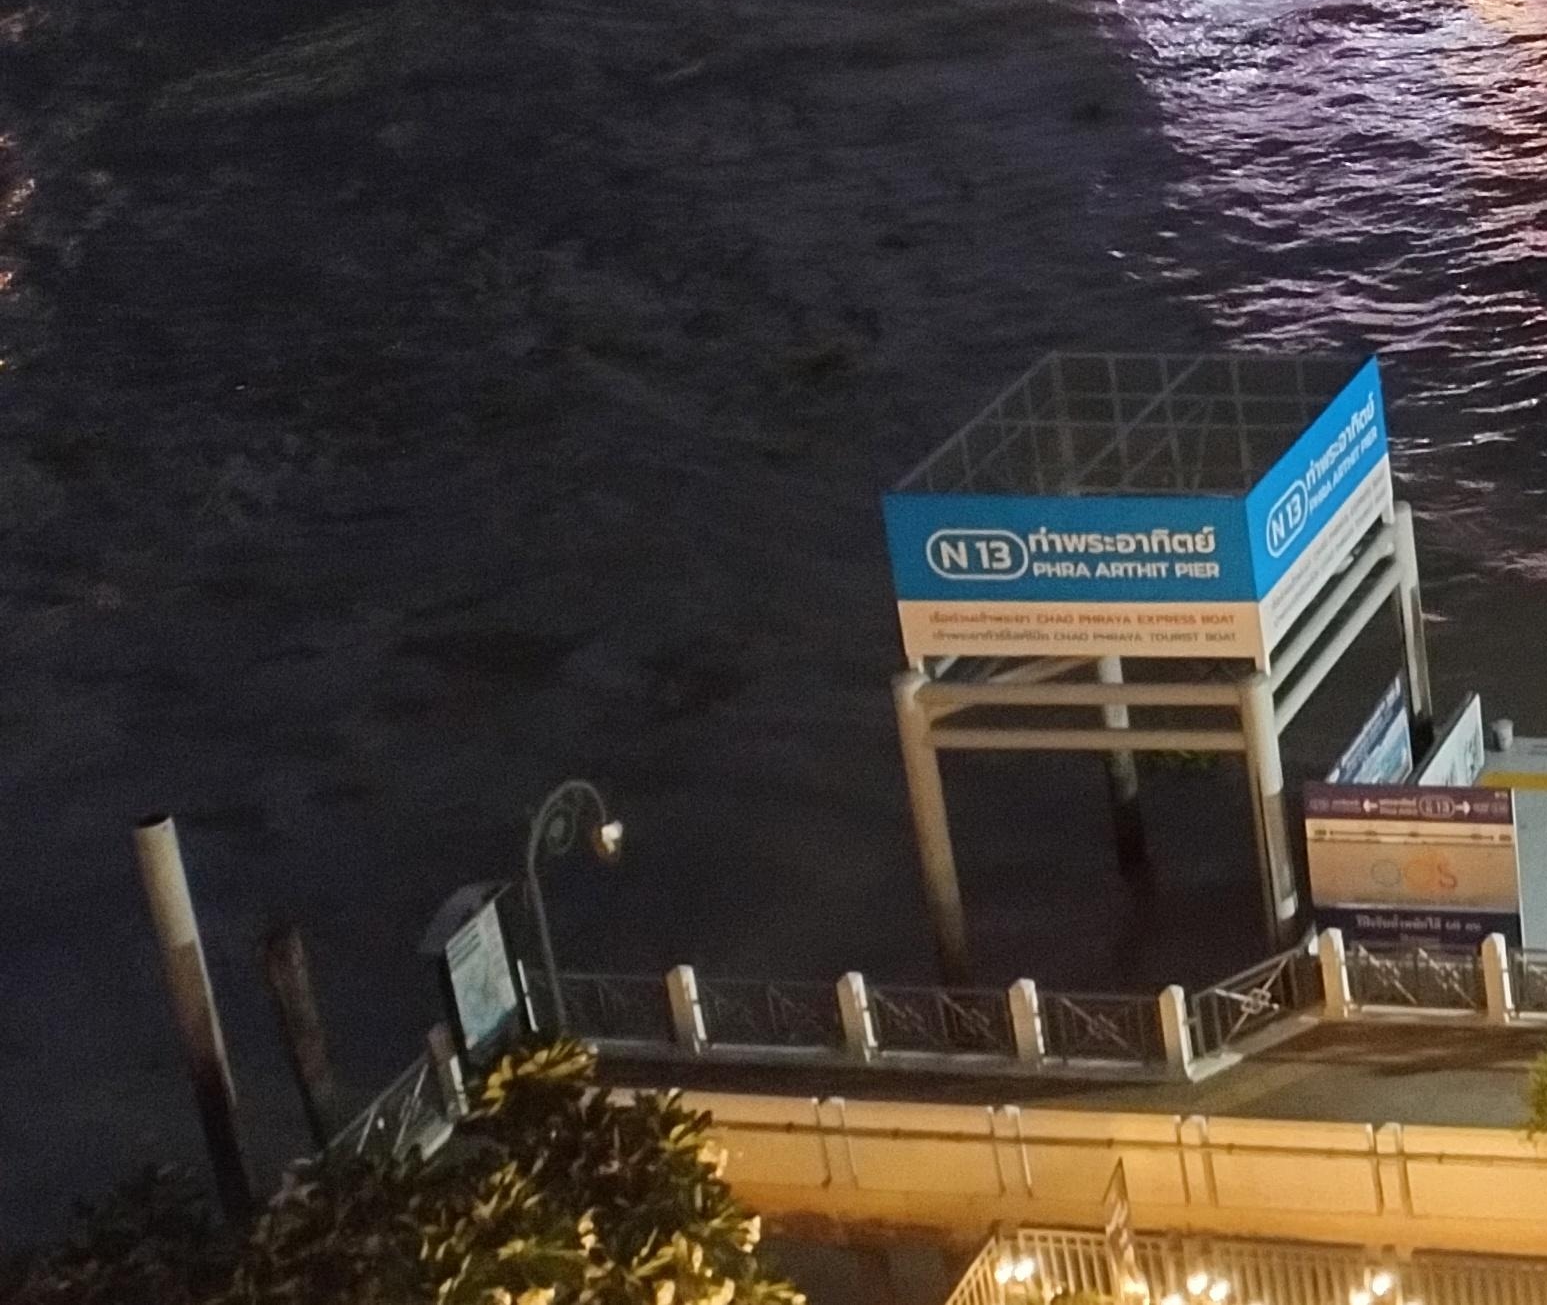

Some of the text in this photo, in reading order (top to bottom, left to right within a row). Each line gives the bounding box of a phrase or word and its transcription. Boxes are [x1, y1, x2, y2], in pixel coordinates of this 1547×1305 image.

[1285, 493, 1302, 529] 13
[1028, 526, 1217, 554] ท่าพระอาทิตย์
[939, 540, 1013, 570] N 13
[1032, 561, 1220, 578] PHRA ARTHIT PIER
[1036, 613, 1073, 625] CHAO
[1078, 613, 1132, 625] PHRAYA
[1136, 613, 1197, 625] EXPRESS
[1201, 613, 1235, 625] BOAT
[1053, 631, 1087, 642] CHAO
[1092, 631, 1143, 642] PHRAYA
[1149, 631, 1199, 642] TOURIST
[1205, 631, 1236, 642] BOAT
